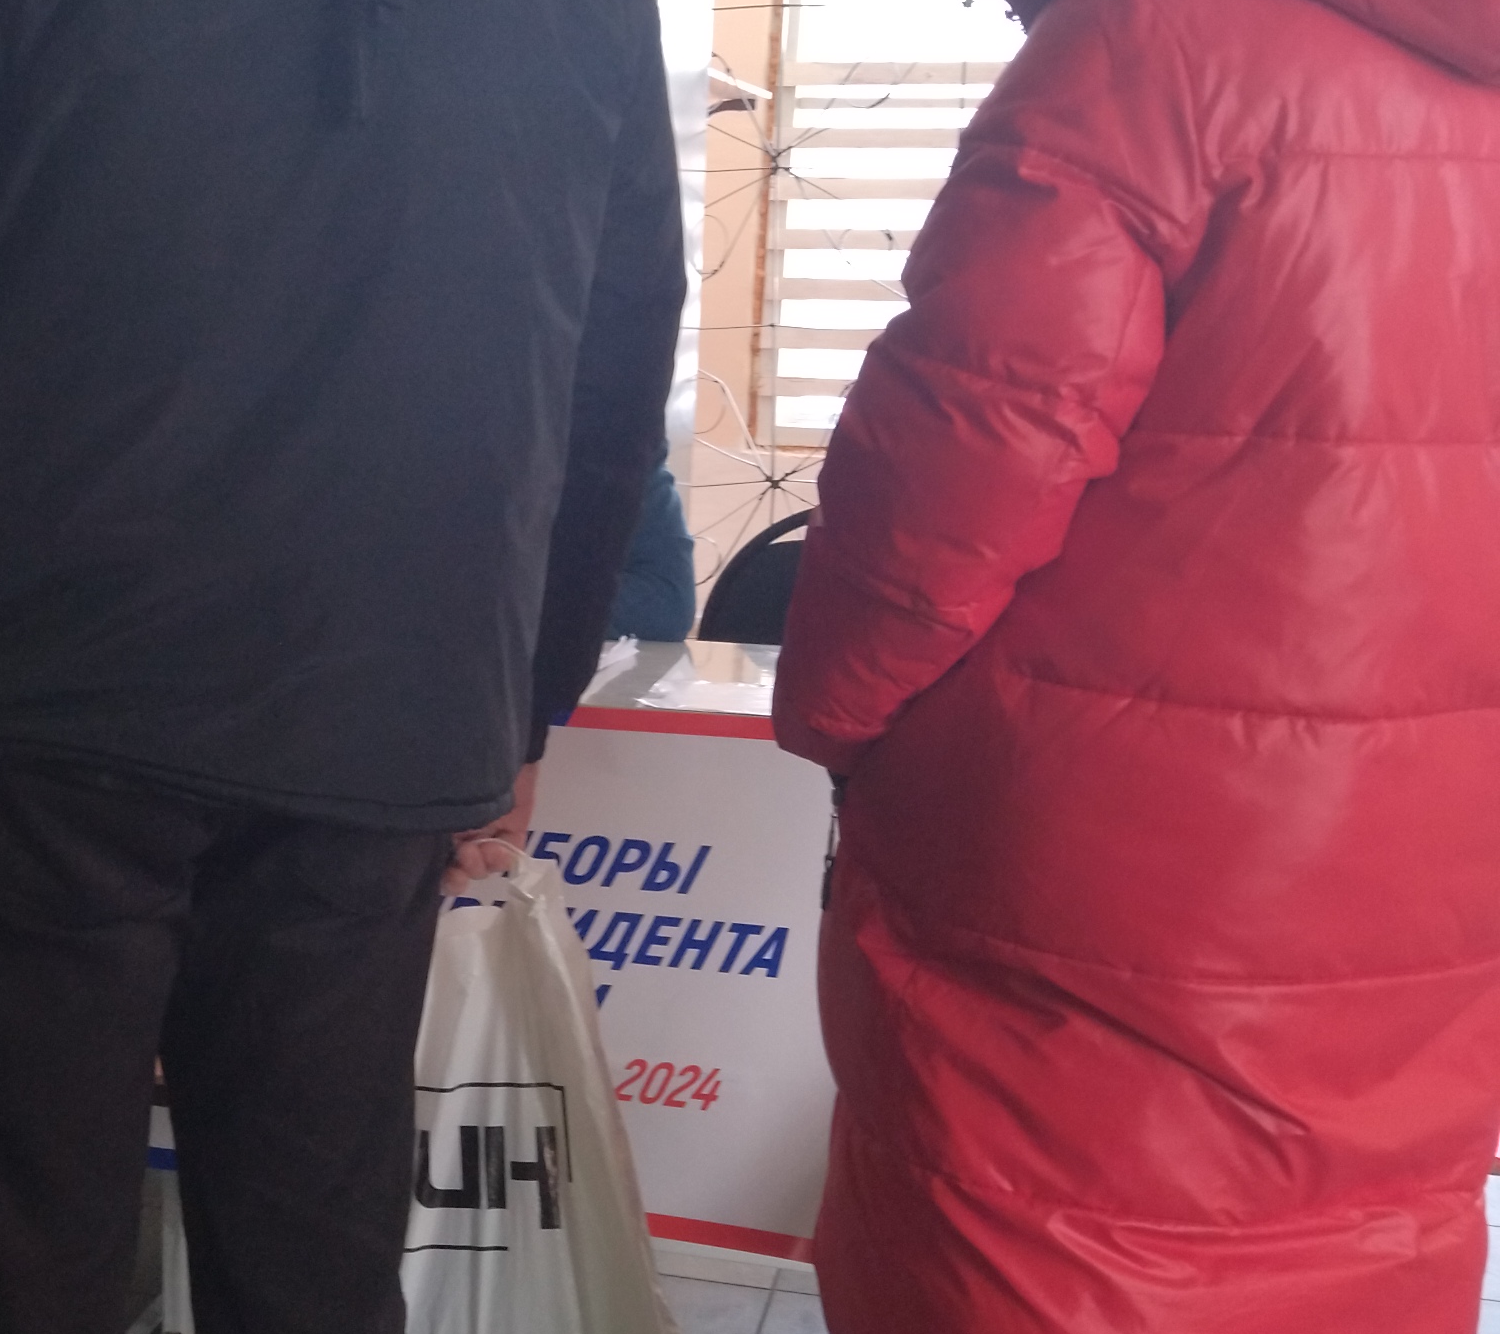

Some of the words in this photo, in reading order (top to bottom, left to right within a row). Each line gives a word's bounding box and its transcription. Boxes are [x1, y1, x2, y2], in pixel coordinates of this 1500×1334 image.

[504, 830, 712, 895] БОРЫ
[441, 895, 790, 979] ДЕНТА
[615, 1058, 722, 1111] 2024
